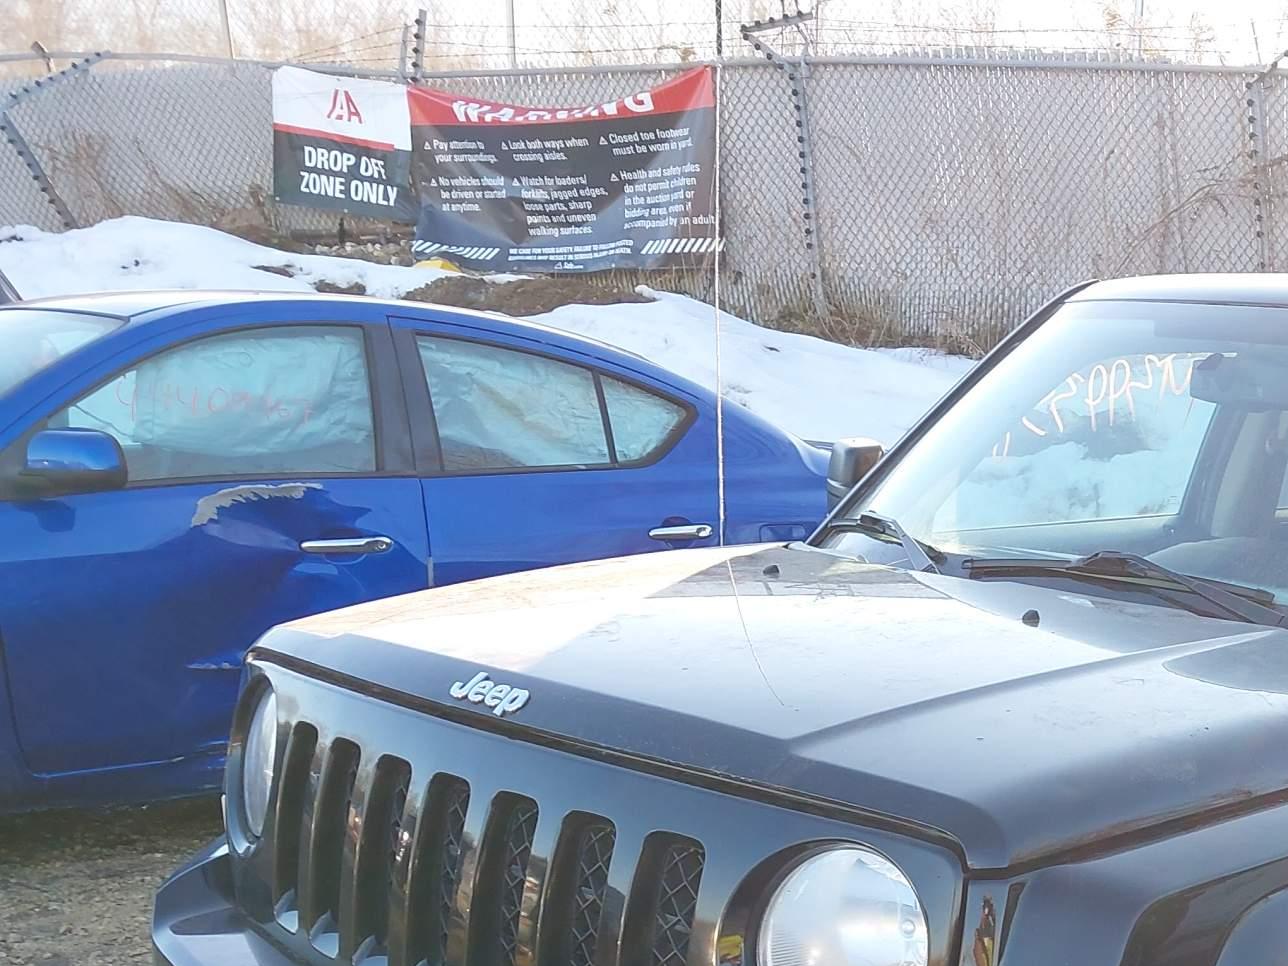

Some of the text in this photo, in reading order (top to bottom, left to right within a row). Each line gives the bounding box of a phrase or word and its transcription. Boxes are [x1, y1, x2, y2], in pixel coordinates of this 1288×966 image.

[609, 128, 690, 144] Closed toe footwear
[433, 139, 448, 151] Pay
[477, 141, 485, 150] to
[508, 137, 590, 151] Look both ways when
[613, 146, 635, 156] must
[636, 143, 648, 154] be
[649, 142, 671, 152] worn
[671, 141, 678, 150] in
[304, 146, 386, 180] DROP OFF
[435, 154, 453, 165] your
[513, 152, 568, 163] crossing aisles.
[620, 162, 701, 181] Health and safety rules
[439, 176, 504, 186] No vehicles should
[520, 176, 545, 186] Watch
[545, 176, 555, 186] for
[624, 176, 697, 193] do not permit children
[300, 171, 397, 207] ZONE ONLY
[441, 190, 451, 199] be
[451, 189, 475, 199] driven
[475, 191, 483, 199] or
[551, 188, 579, 200] jagged
[579, 187, 609, 198] edges,
[625, 196, 633, 206] in
[633, 194, 646, 205] the
[646, 193, 671, 204] auction
[685, 190, 695, 199] or
[442, 202, 482, 214] at anytime.
[523, 200, 593, 212] loose parts, sharp
[625, 207, 650, 219] bidding
[668, 204, 685, 213] even
[685, 201, 693, 212] if
[527, 214, 597, 225] points and uneven
[669, 215, 678, 228] by
[680, 216, 692, 225] an
[528, 225, 559, 237] walking
[450, 672, 530, 717] Jeep
